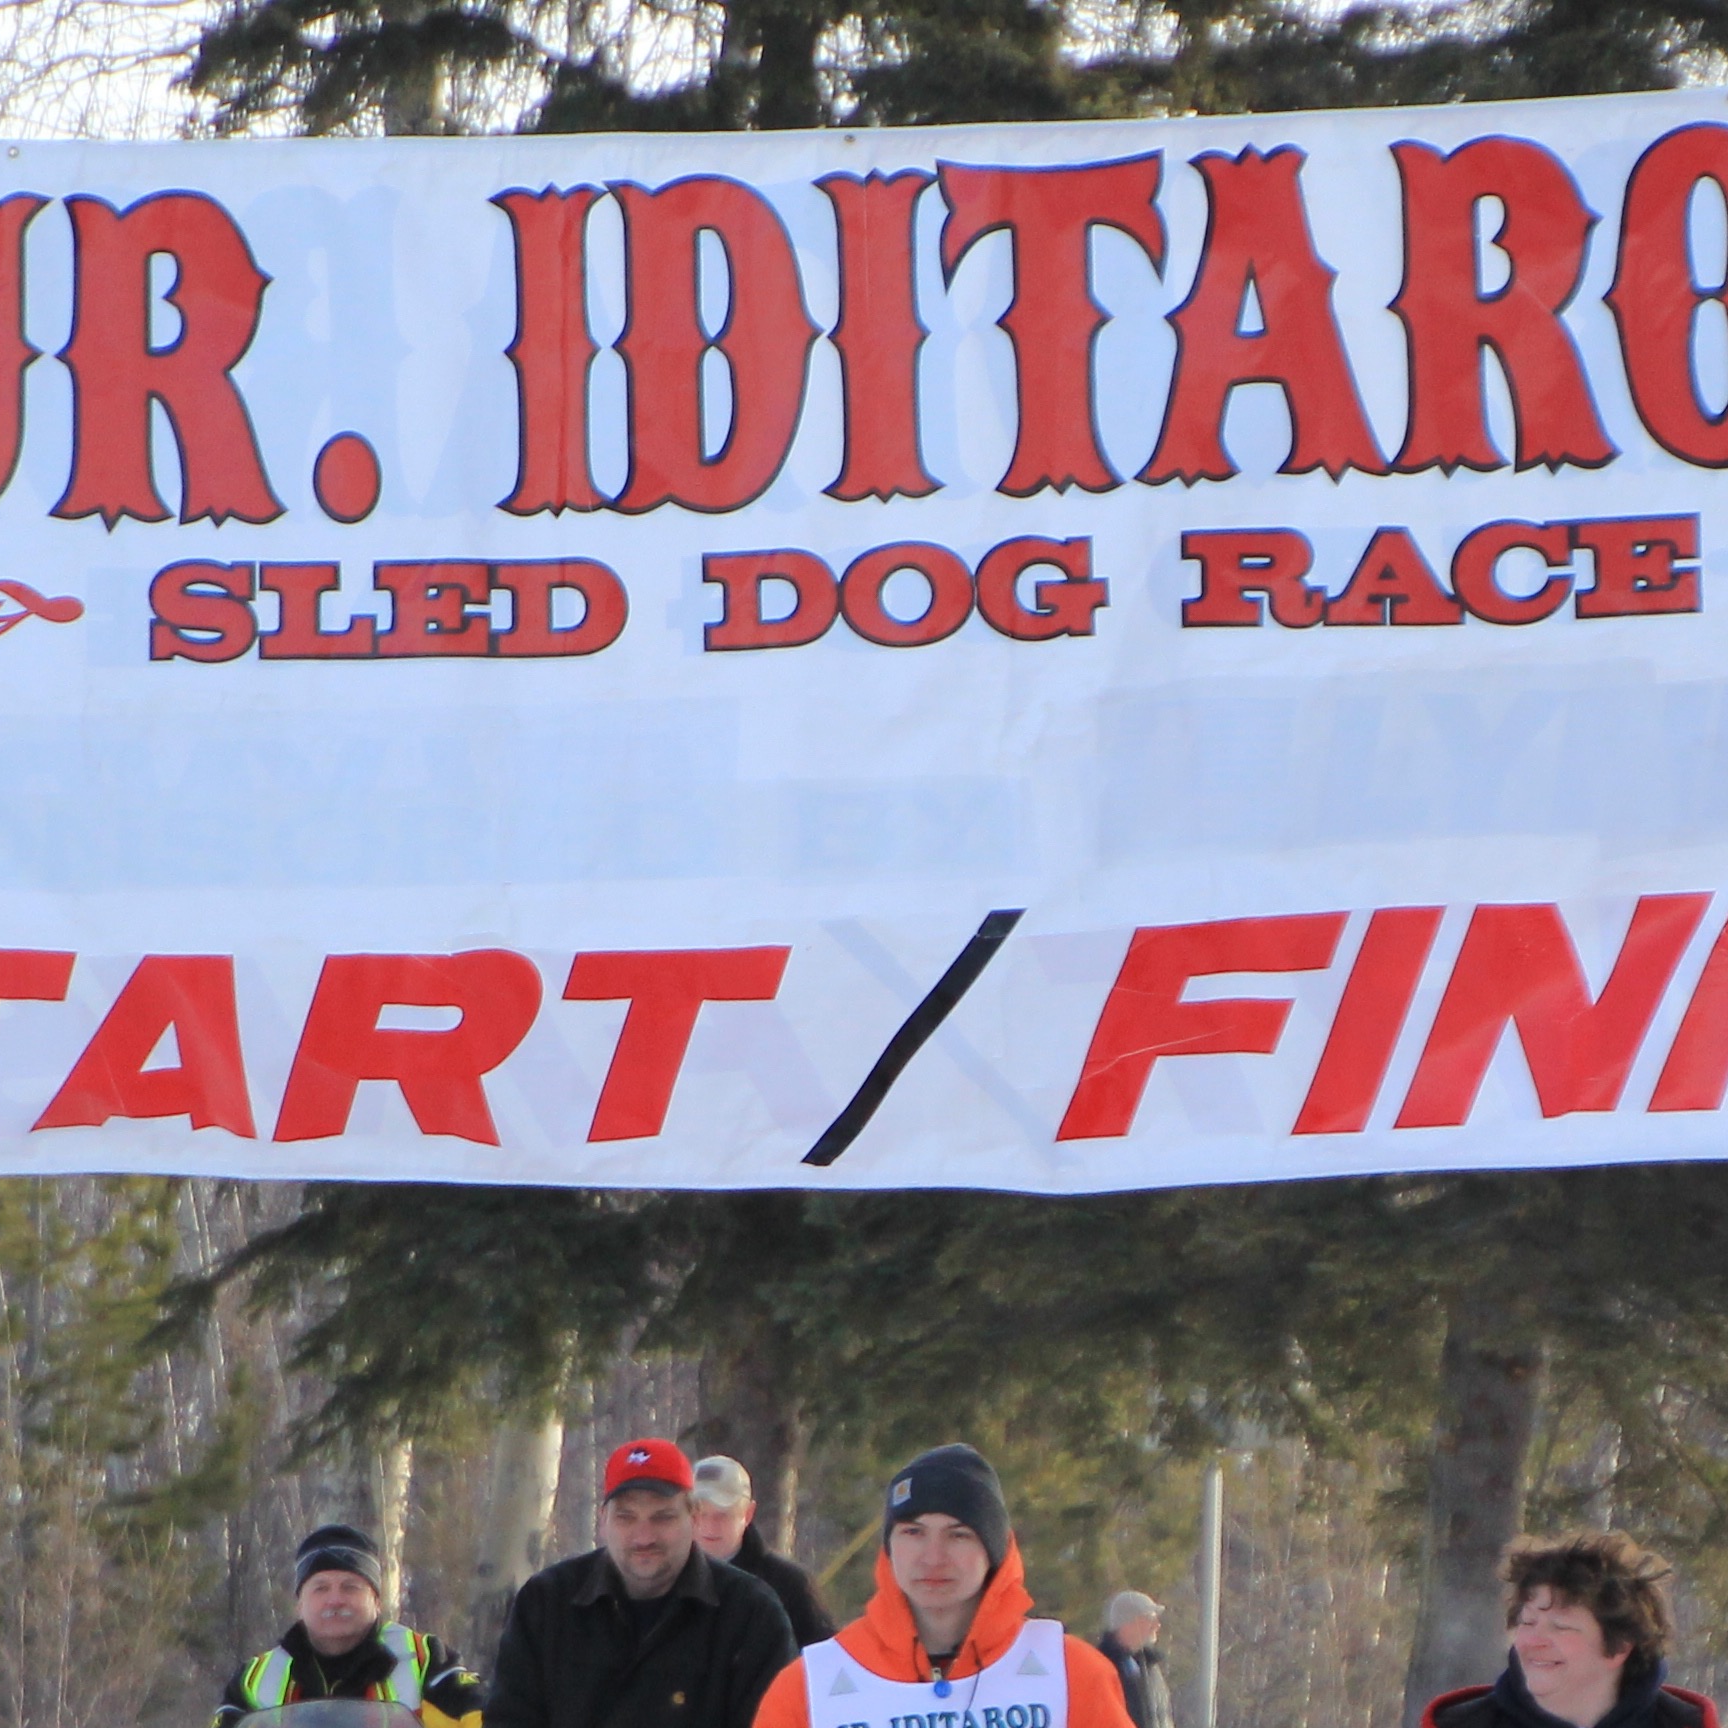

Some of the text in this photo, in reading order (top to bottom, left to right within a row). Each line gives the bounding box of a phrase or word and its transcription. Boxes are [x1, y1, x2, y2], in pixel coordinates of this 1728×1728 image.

[149, 511, 1704, 662] SLED DOG RACE
[801, 910, 1023, 1167] /
